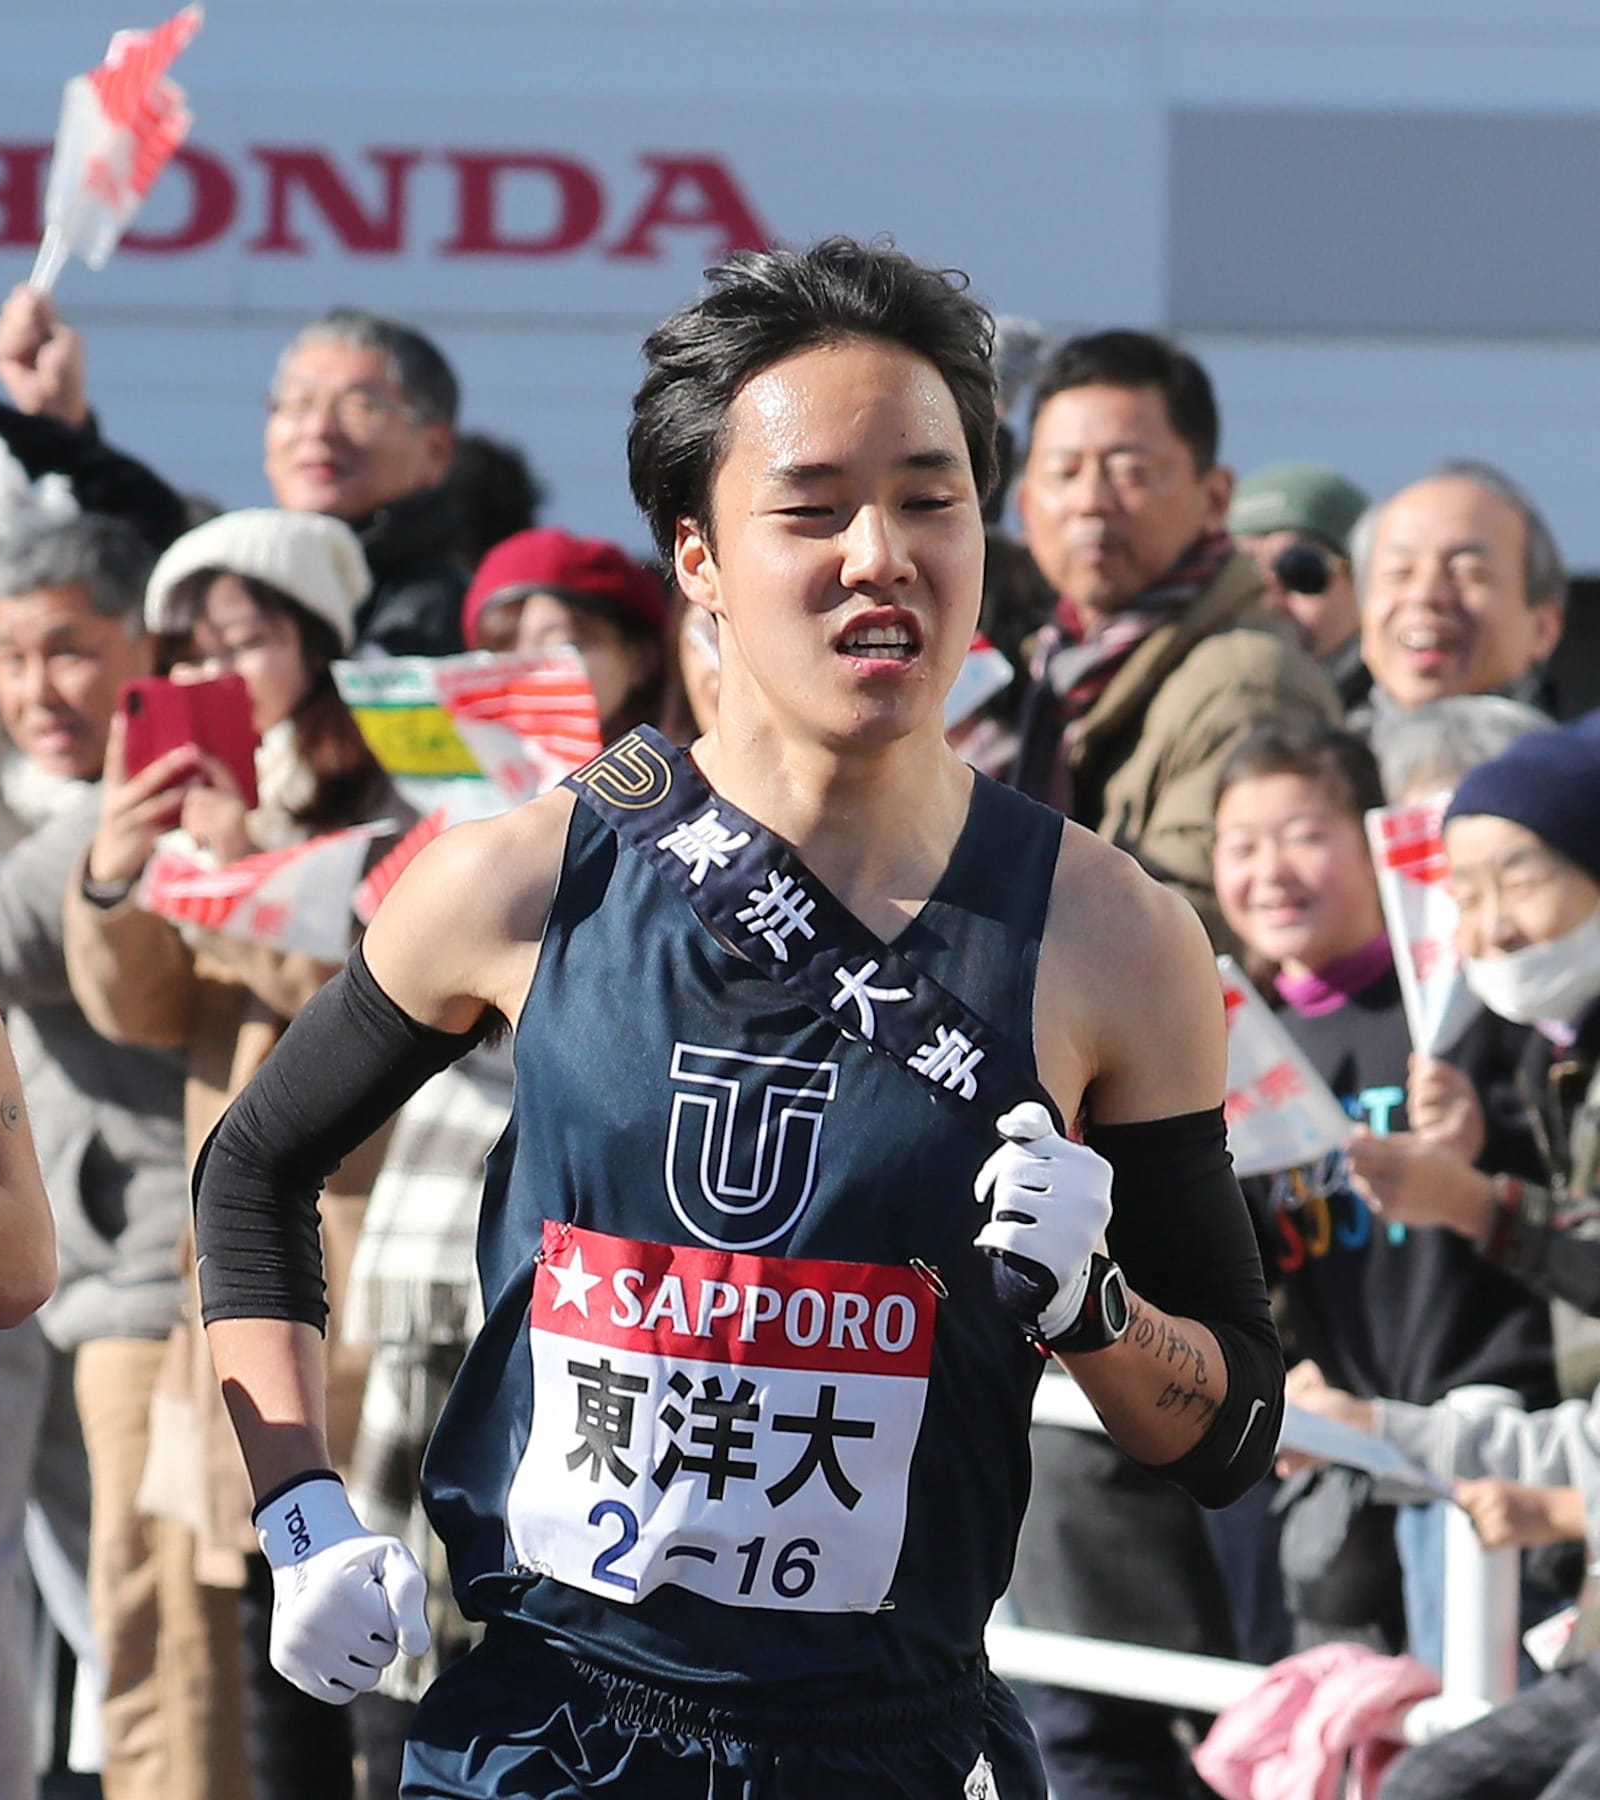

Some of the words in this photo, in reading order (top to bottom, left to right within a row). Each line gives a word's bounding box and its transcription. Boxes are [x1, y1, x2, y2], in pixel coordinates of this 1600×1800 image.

[656, 808, 986, 1102] 東洋大学
[609, 1267, 918, 1354] SAPPORO
[565, 1358, 876, 1512] 東洋大
[284, 1503, 312, 1557] TOYO
